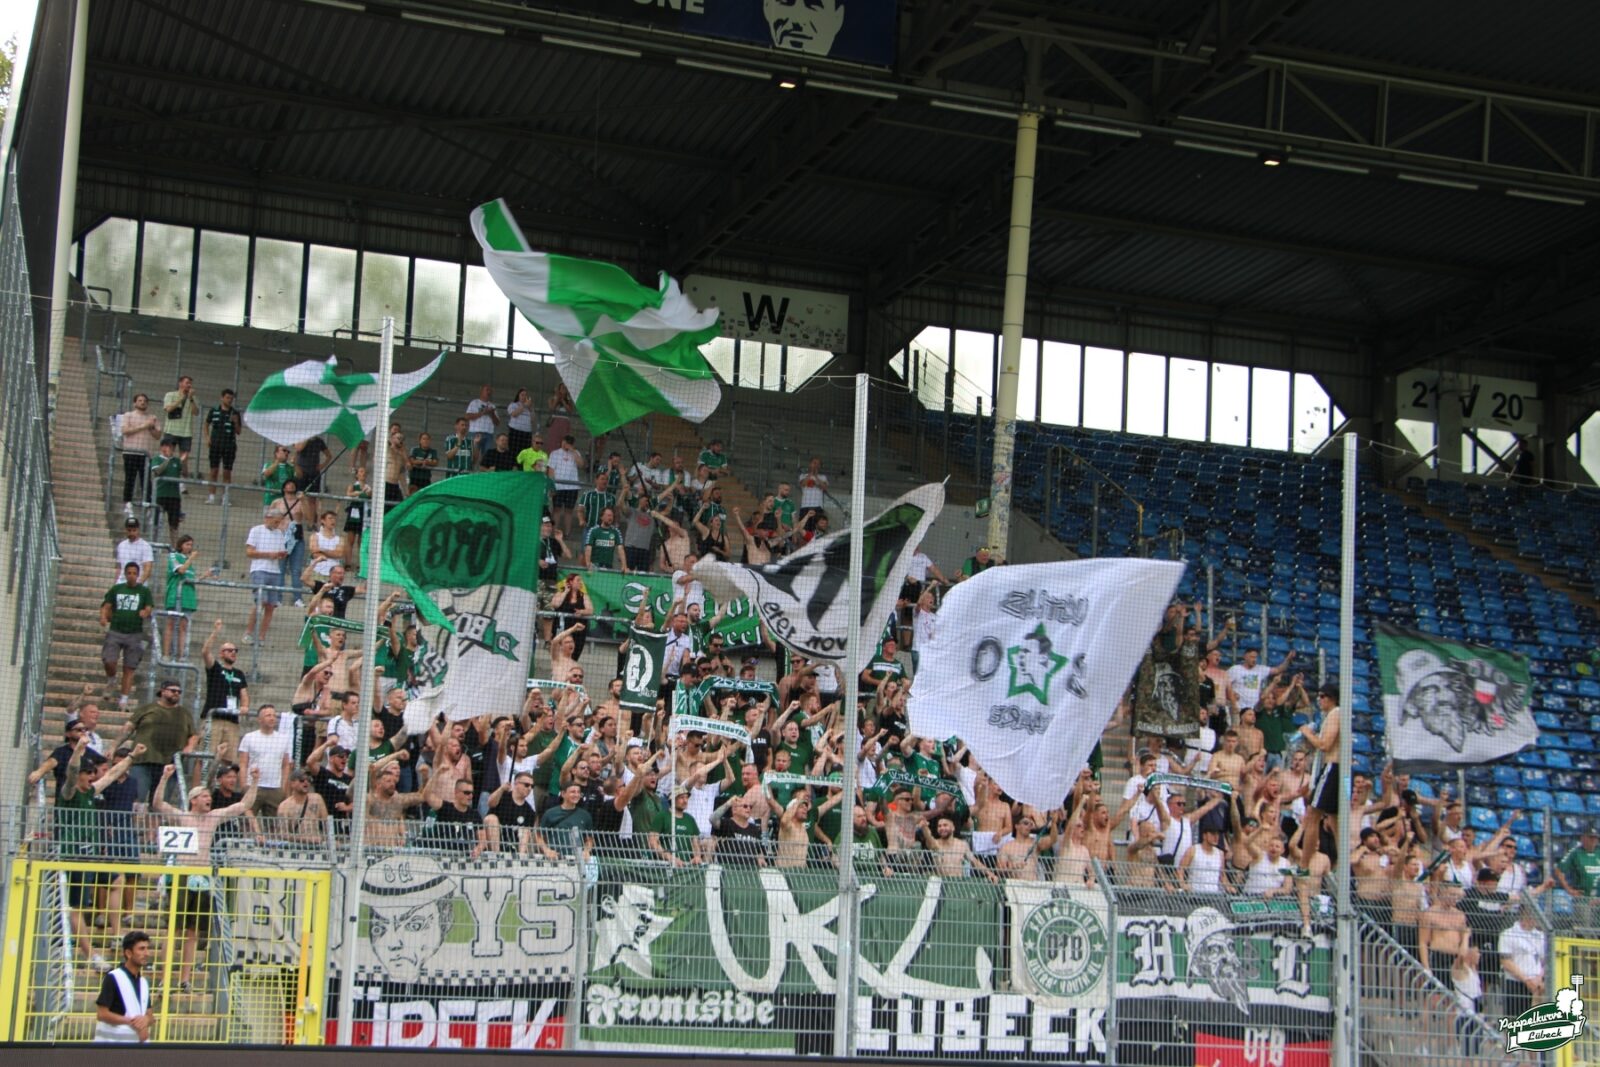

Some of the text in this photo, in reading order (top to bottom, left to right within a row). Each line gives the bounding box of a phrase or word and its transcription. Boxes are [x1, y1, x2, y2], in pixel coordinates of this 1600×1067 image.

[742, 291, 790, 334] W
[1491, 391, 1523, 421] 20
[163, 830, 194, 849] 27
